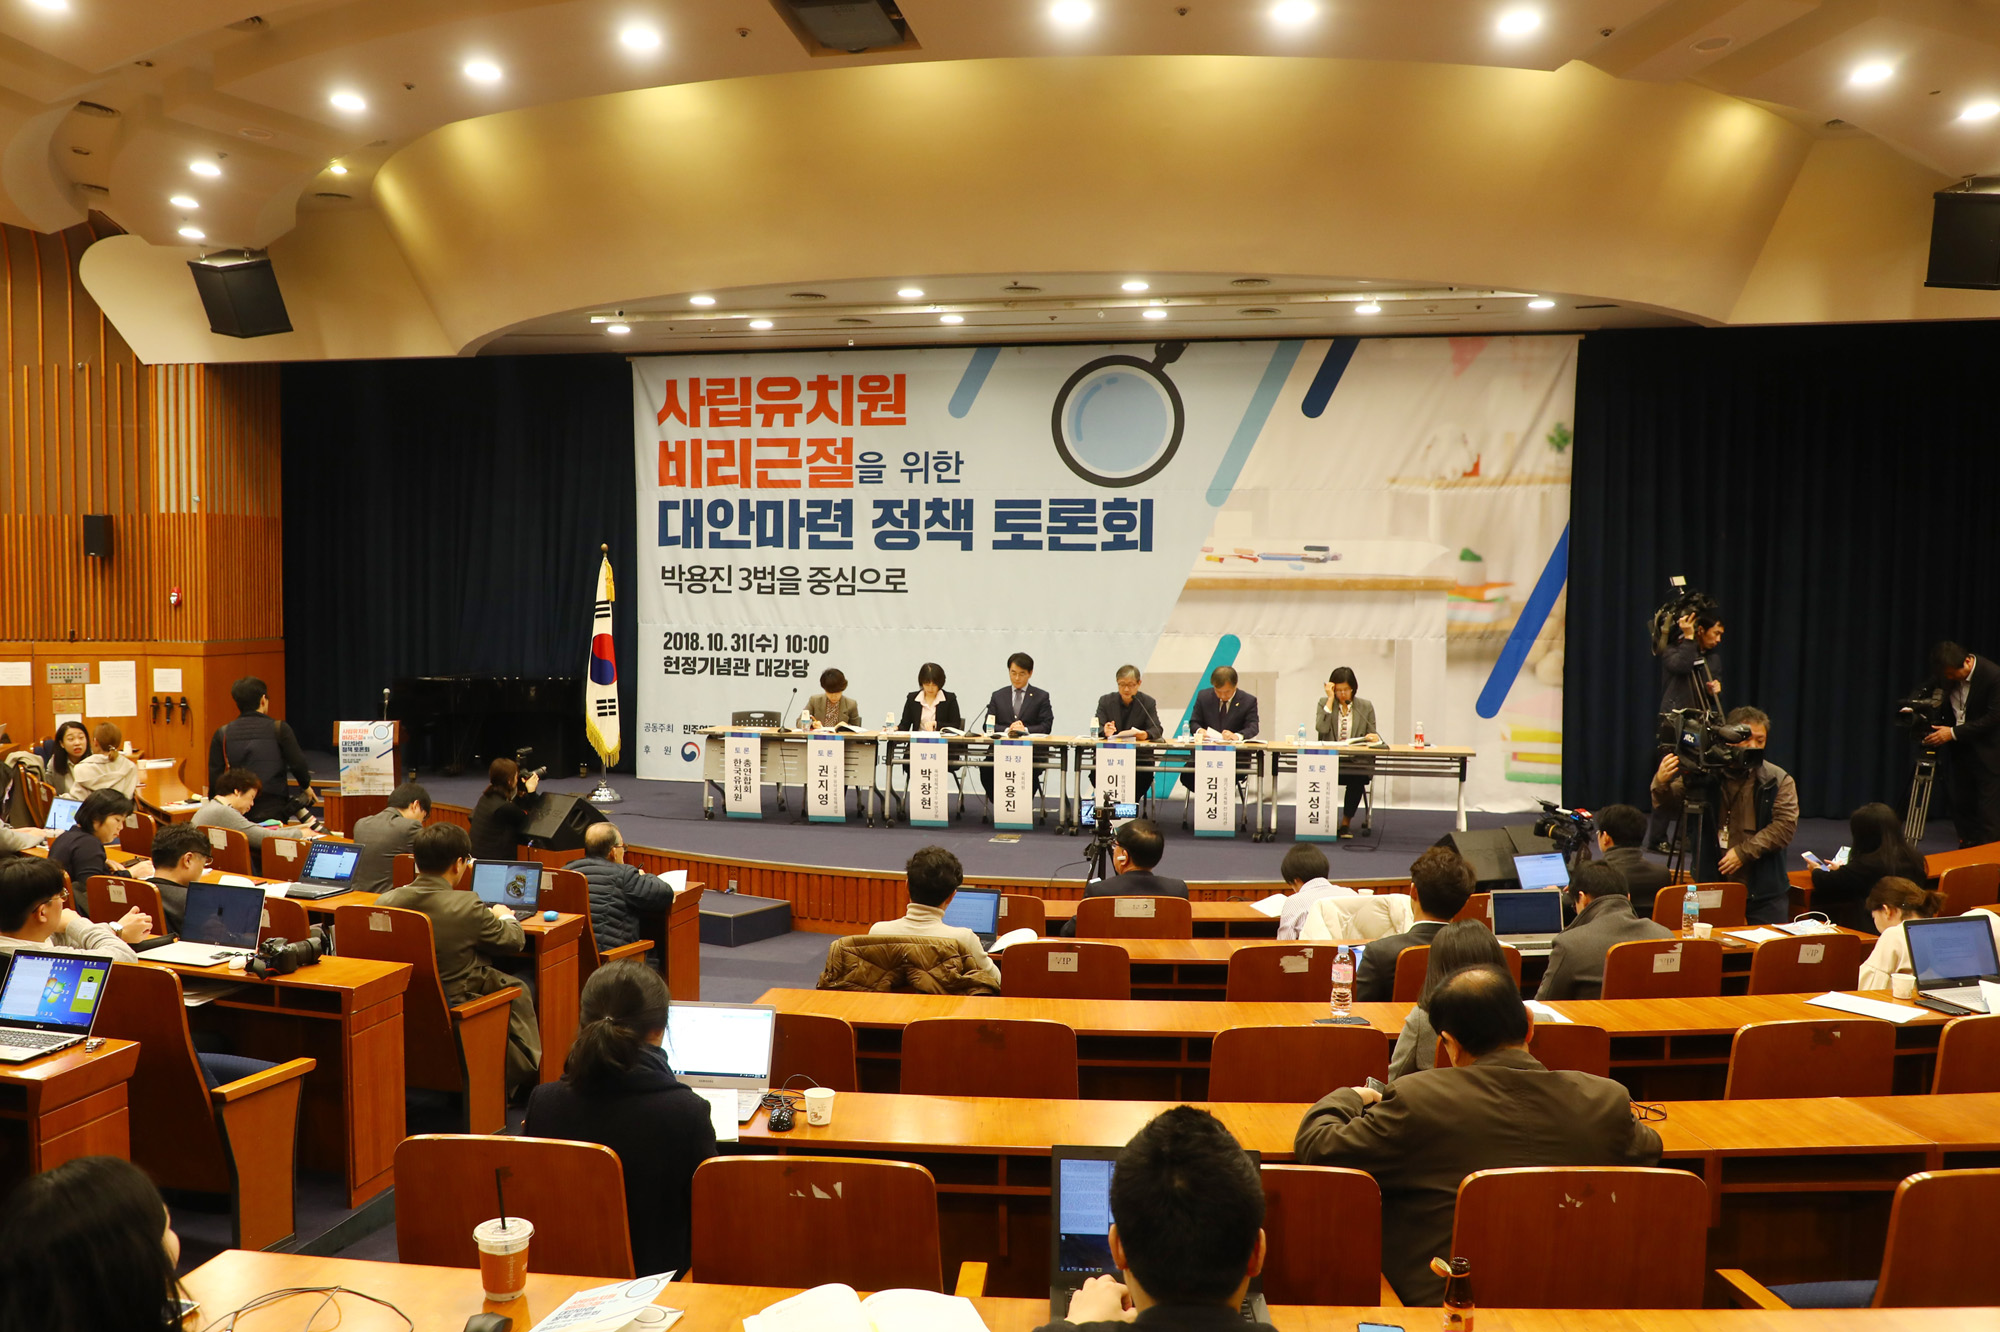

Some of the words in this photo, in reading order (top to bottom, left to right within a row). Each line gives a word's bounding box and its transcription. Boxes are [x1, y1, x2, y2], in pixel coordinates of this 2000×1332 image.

[657, 374, 906, 429] 사립유치원
[659, 437, 886, 488] 비리근절을
[901, 451, 964, 484] 위한
[658, 499, 853, 550] 대안마련
[872, 498, 973, 551] 정책
[992, 498, 1153, 552] 토론회
[662, 564, 732, 594] 박용진
[739, 565, 801, 595] 3법을
[807, 566, 908, 595] 중심으로
[786, 635, 829, 654] 10:00
[664, 656, 750, 676] 헌정기념관
[756, 659, 809, 678] 대강당
[644, 723, 674, 733] 공동주최
[734, 759, 742, 801] 한국유치원
[743, 759, 751, 793] 총연합회
[818, 766, 828, 805] 권지영
[921, 769, 931, 809] 박창현
[1005, 771, 1016, 812] 박용진
[1207, 777, 1217, 819] 김거성
[1308, 782, 1320, 824] 조성실
